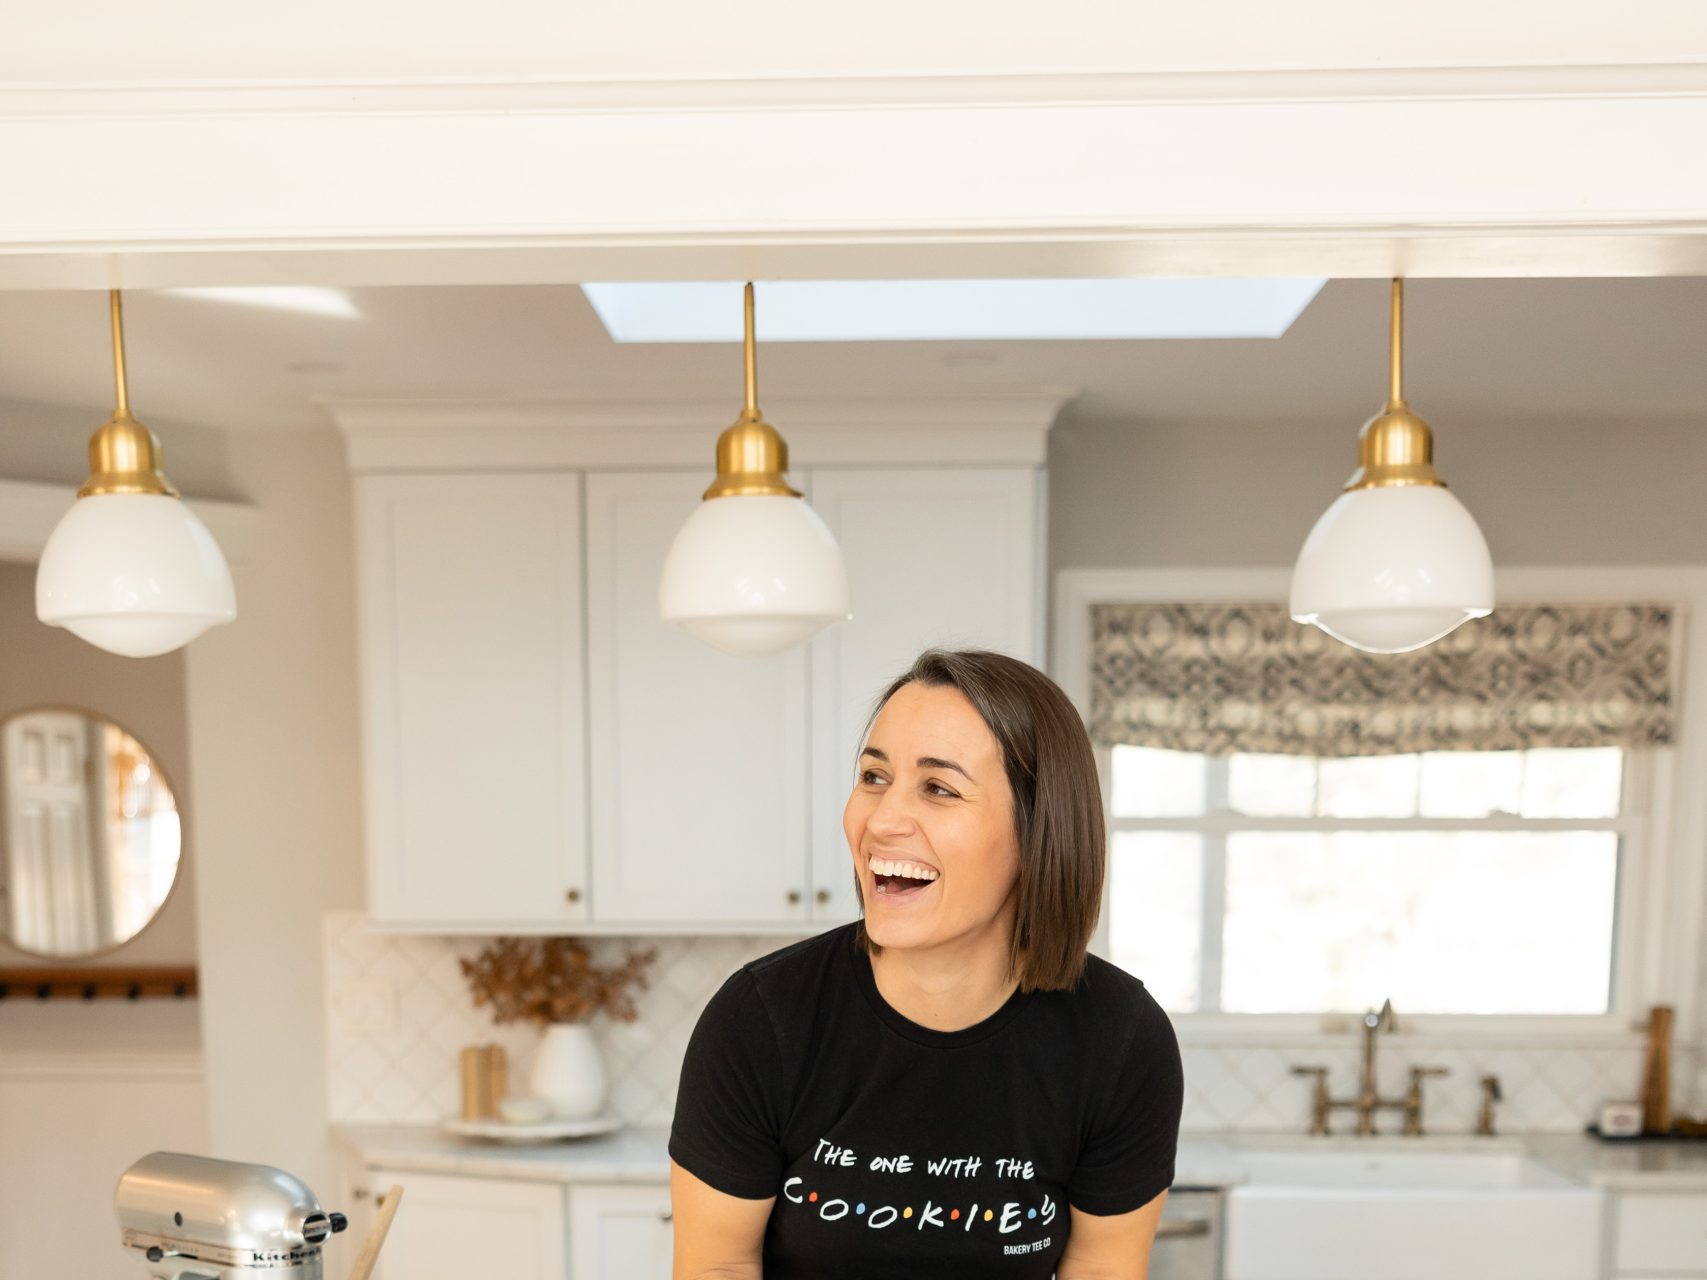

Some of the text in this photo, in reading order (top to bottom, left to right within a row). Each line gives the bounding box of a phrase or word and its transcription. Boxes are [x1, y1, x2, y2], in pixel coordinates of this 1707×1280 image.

[813, 1137, 1035, 1180] THE ONE WITH THE
[1003, 1244, 1031, 1256] BAKERY
[1031, 1240, 1043, 1252] TEE
